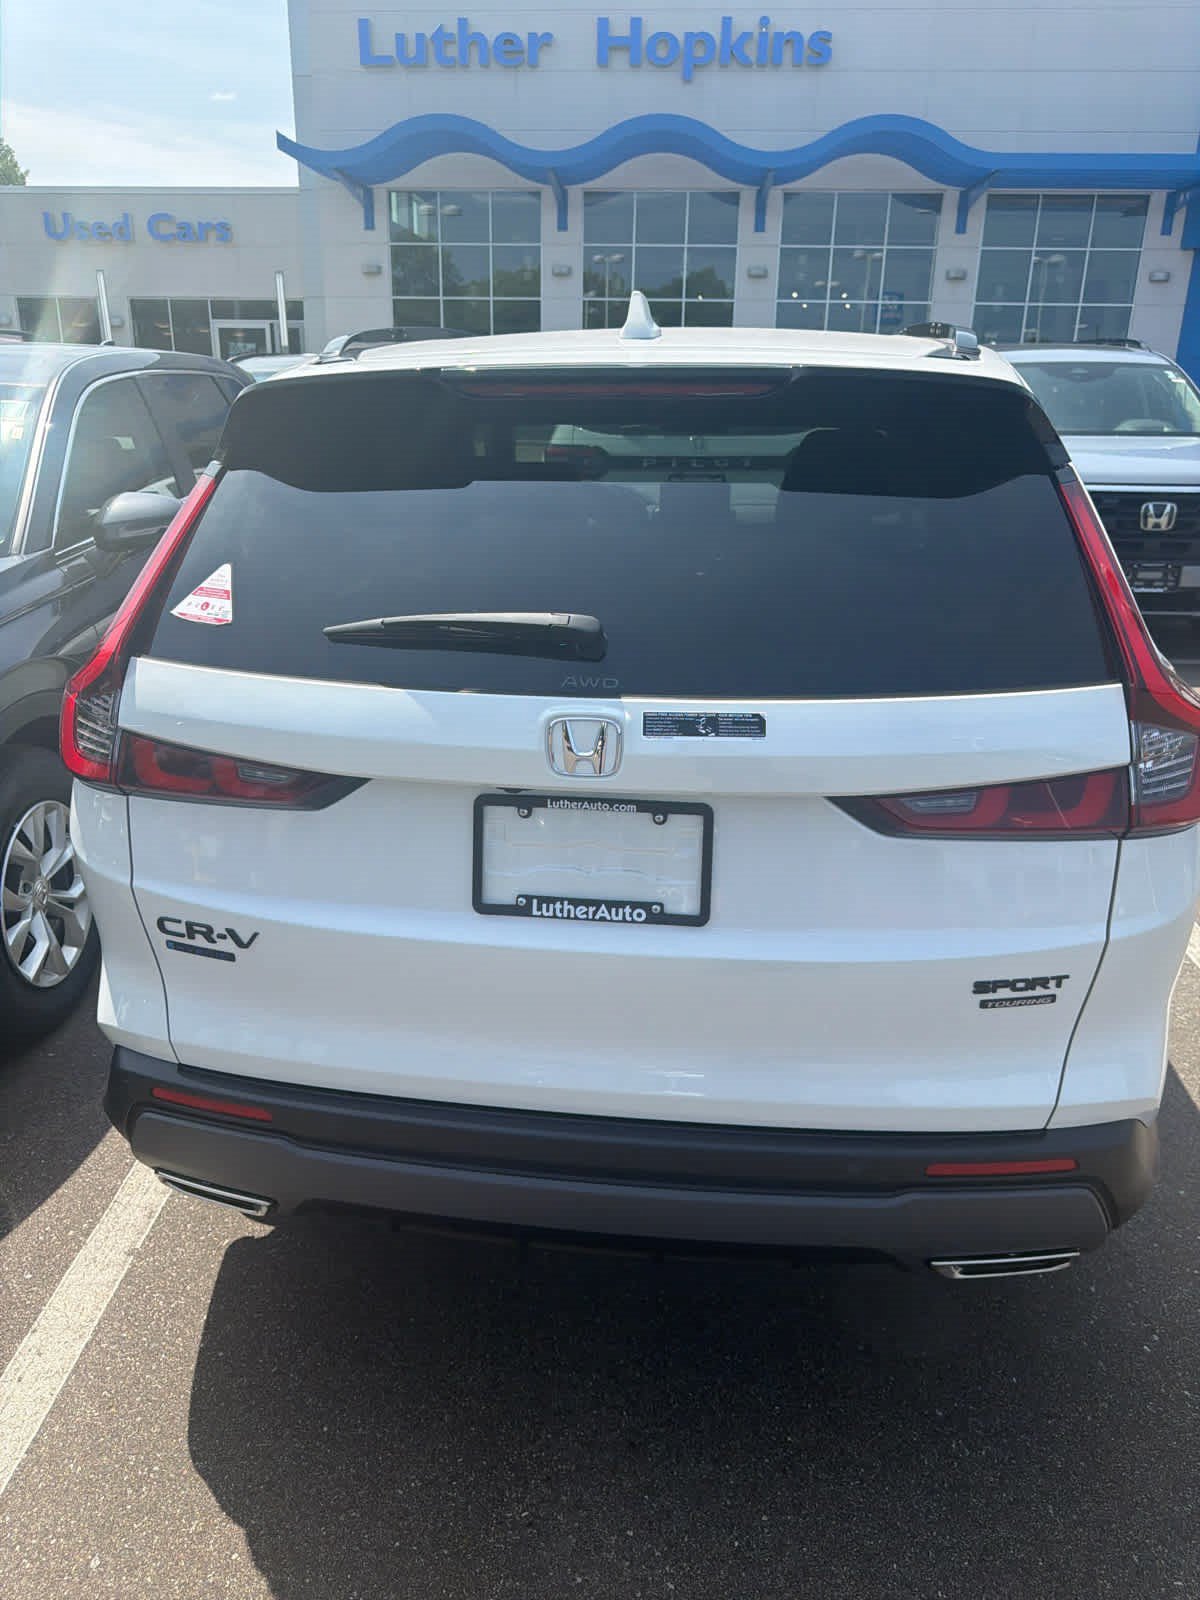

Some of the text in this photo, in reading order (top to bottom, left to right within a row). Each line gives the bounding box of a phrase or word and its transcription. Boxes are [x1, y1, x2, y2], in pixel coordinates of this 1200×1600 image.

[357, 15, 833, 82] Luther Hopkins
[42, 211, 233, 242] Used Cars
[561, 674, 620, 690] AWD
[546, 798, 637, 812] LutherAuto.com
[531, 898, 647, 922] LutherAuto
[157, 916, 260, 949] CR-V
[971, 974, 1070, 995] SPORT
[984, 996, 1053, 1009] TOURING
